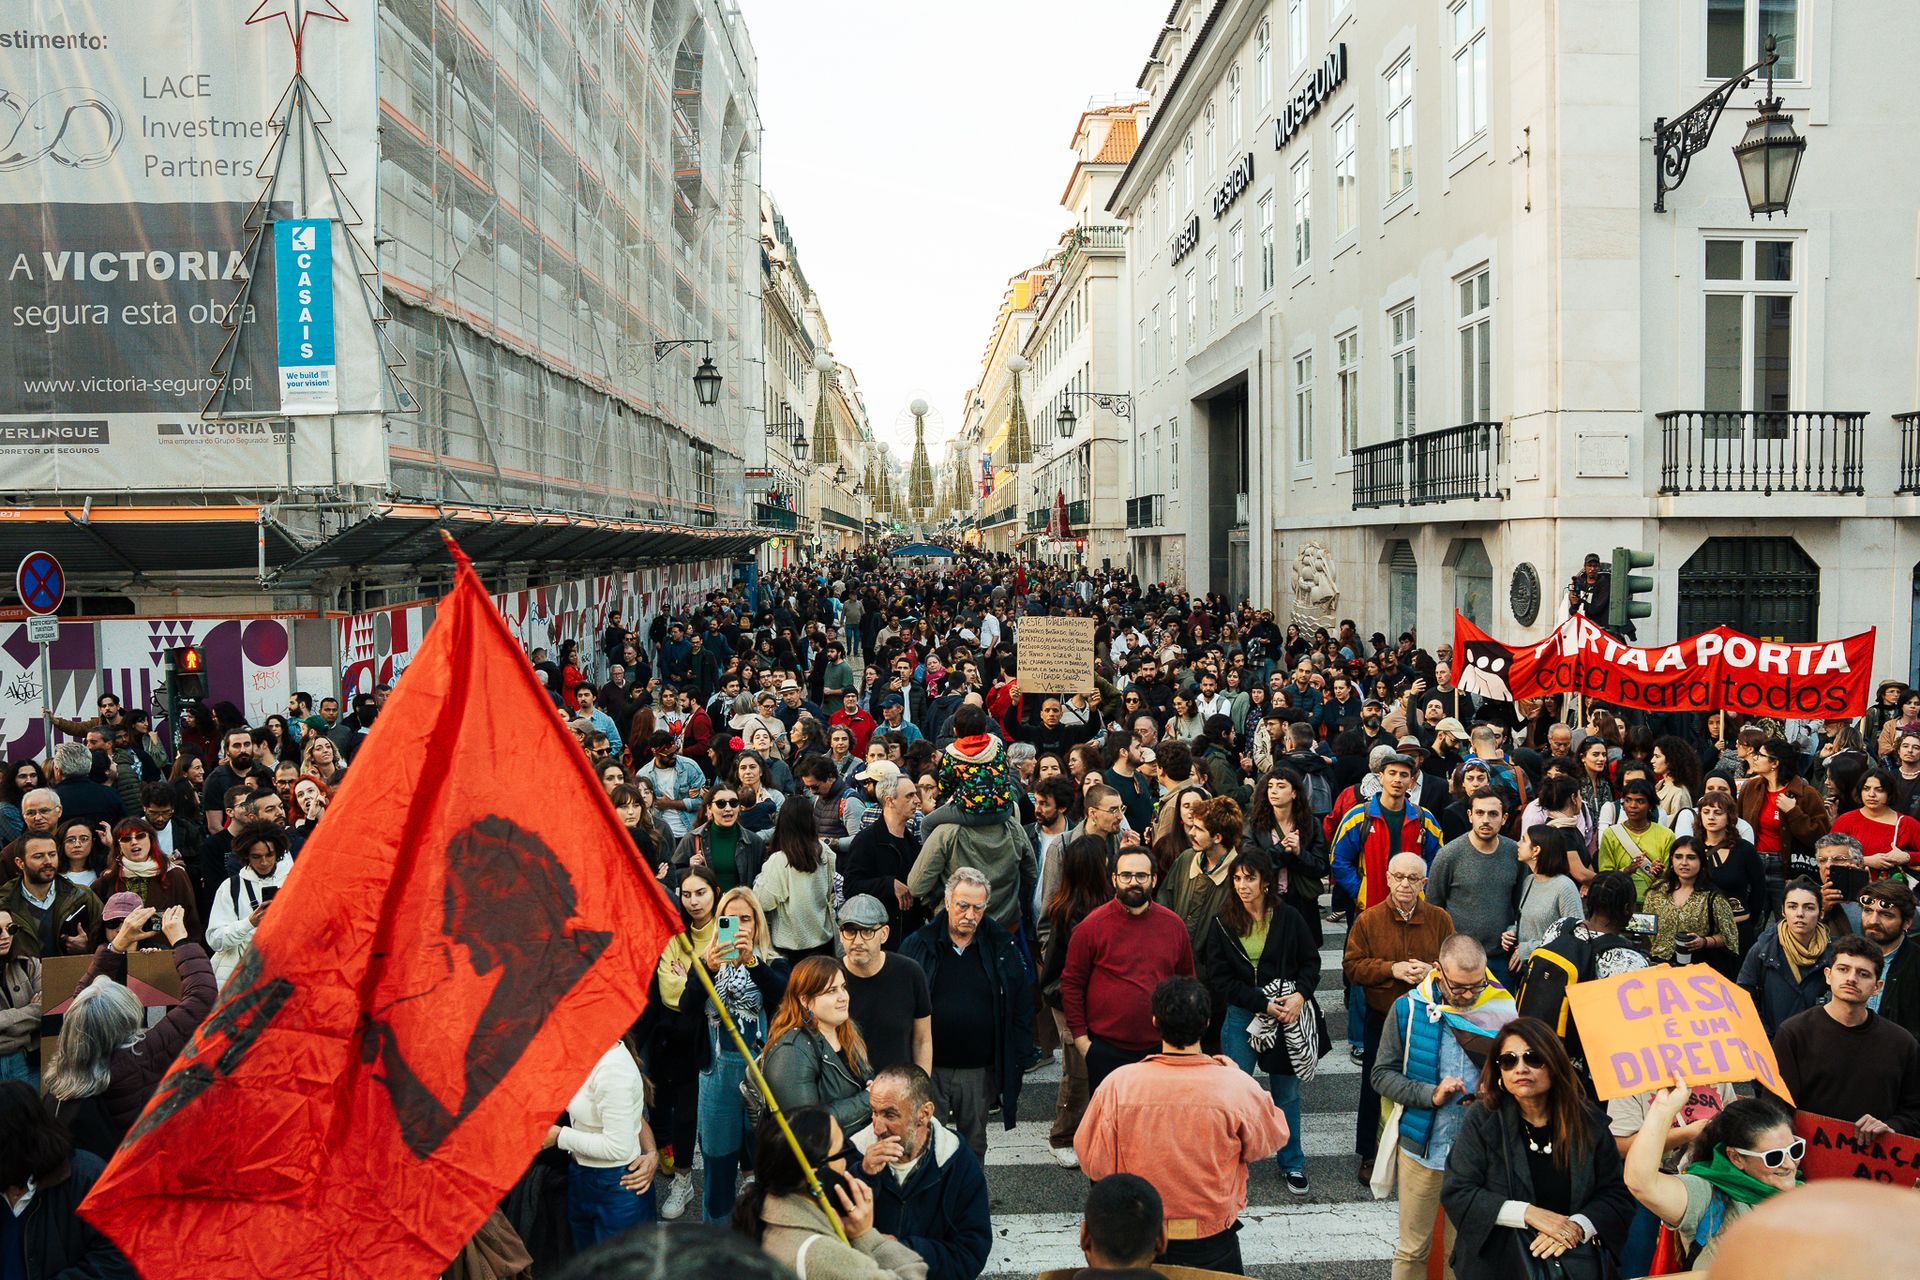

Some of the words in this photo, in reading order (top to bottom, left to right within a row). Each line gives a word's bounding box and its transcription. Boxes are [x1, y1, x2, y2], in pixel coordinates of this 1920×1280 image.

[143, 74, 212, 99] LACE
[143, 115, 290, 138] Investment
[144, 155, 253, 177] Partners
[1171, 215, 1200, 267] MUSEU
[1213, 152, 1255, 220] DESIGN
[1275, 42, 1348, 151] MUSEUM
[8, 253, 34, 280] A
[42, 250, 250, 282] VICTORIA
[13, 304, 109, 333] segura
[122, 301, 176, 325] esta
[189, 299, 257, 325] obra
[297, 254, 314, 359] CASAIS
[24, 376, 253, 397] www.victoria-seguros.pt
[286, 372, 298, 380] We
[299, 371, 319, 379] build
[286, 381, 304, 389] your
[304, 379, 330, 387] vision!
[187, 422, 266, 435] VICTORIA
[1654, 645, 1687, 673] A
[1696, 633, 1851, 676] PORTA
[1535, 661, 1608, 693] casa
[1619, 677, 1710, 707] para
[1721, 674, 1848, 713] todos
[1616, 975, 1742, 1020] CASA
[1663, 1017, 1682, 1038] É
[1690, 1017, 1731, 1037] UM
[1610, 1037, 1775, 1089] DIREITO
[1685, 1093, 1723, 1112] SSA
